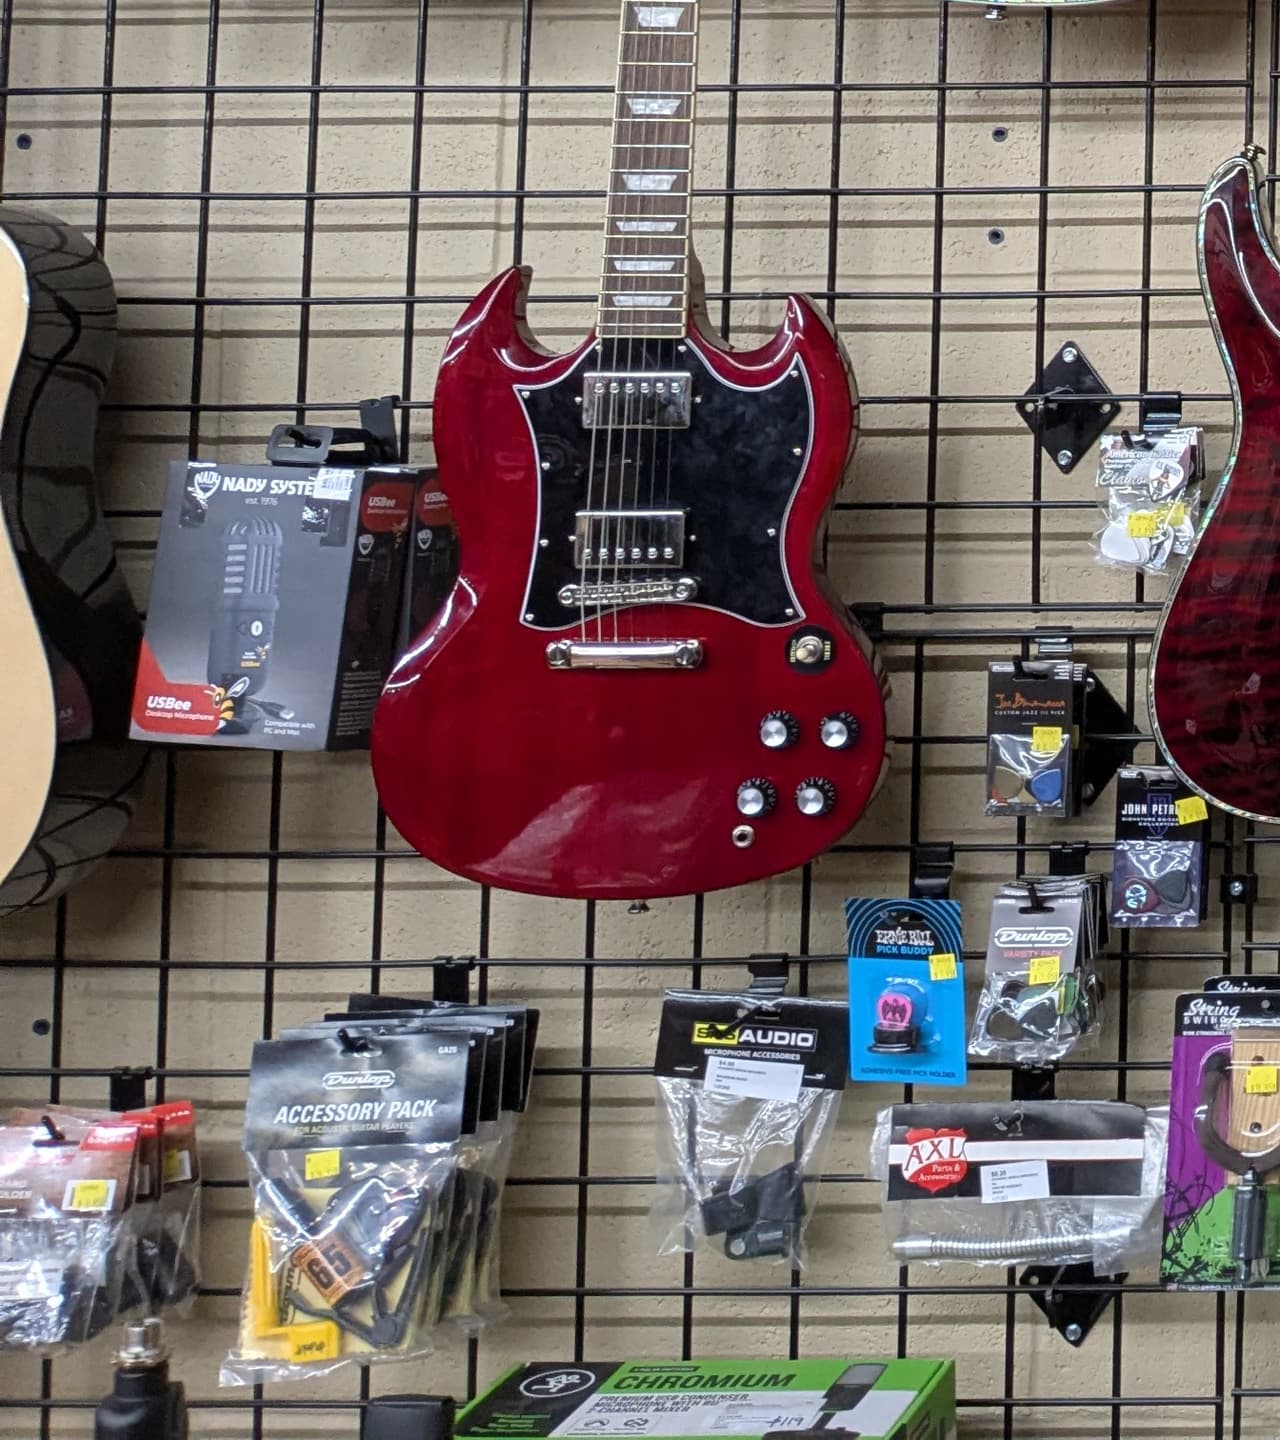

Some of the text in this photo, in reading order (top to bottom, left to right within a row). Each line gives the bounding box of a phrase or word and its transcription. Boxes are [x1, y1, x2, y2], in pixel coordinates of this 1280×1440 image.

[222, 476, 315, 496] NADY SYSTE
[146, 695, 192, 711] USBee
[1121, 803, 1148, 816] JOHN
[999, 930, 1069, 945] Dunlop
[876, 945, 935, 956] PICK BUDDY
[1183, 998, 1241, 1022] String
[739, 1031, 813, 1047] AUDIO
[704, 1047, 801, 1061] MICROPHONE ACCESSORIES
[326, 1072, 393, 1088] Dunlop
[274, 1099, 437, 1125] ACCESSORY PACK
[904, 1137, 965, 1171] AXL
[613, 1373, 797, 1390] CHROMIUM
